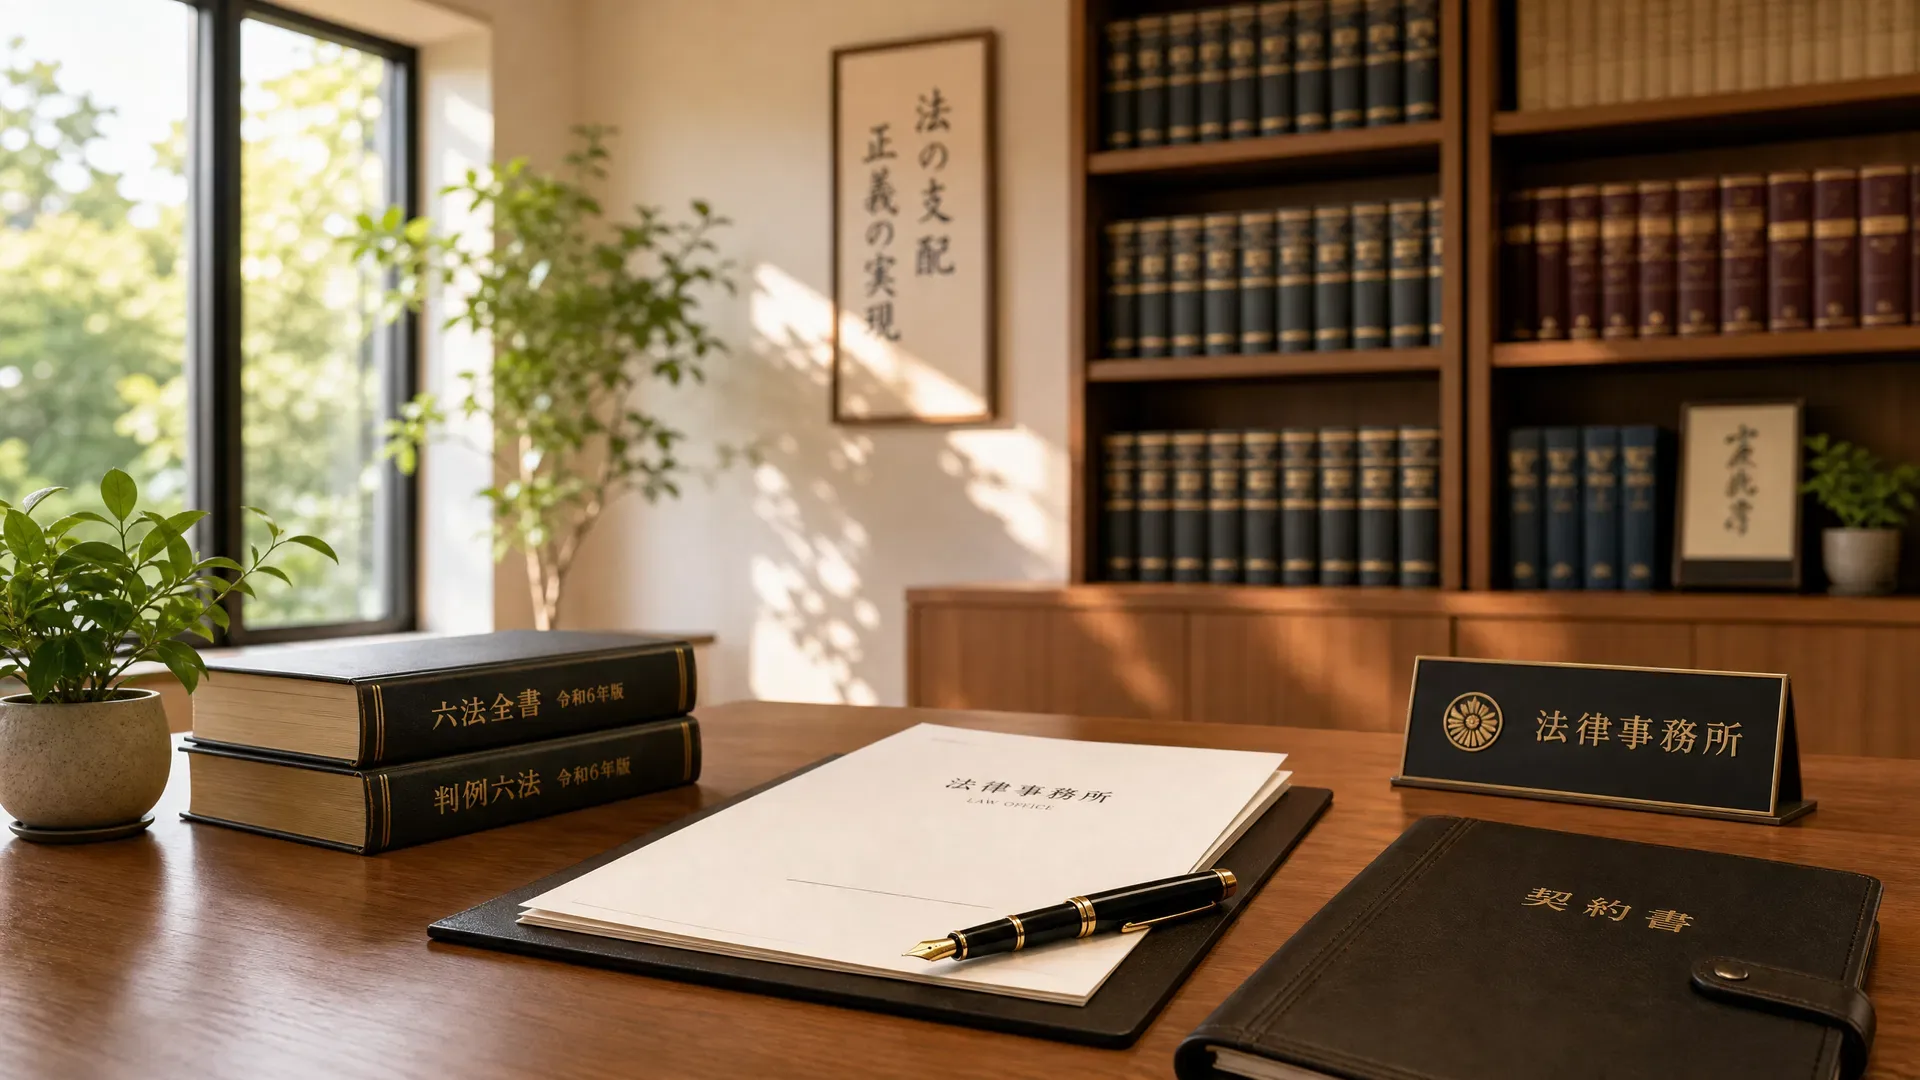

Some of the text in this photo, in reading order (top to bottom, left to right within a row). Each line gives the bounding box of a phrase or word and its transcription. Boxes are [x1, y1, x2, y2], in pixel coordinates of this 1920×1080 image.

[914, 87, 955, 277] 法の支配
[862, 122, 901, 343] 正義の実現
[431, 682, 625, 731] 六法全書 令和6年版
[1535, 709, 1744, 758] 法律事務所
[433, 755, 632, 815] 判例六法 令和6年版
[945, 777, 1114, 804] 法律事務所
[966, 797, 1055, 811] LAW OFFICE
[1520, 887, 1694, 933] 契約書
